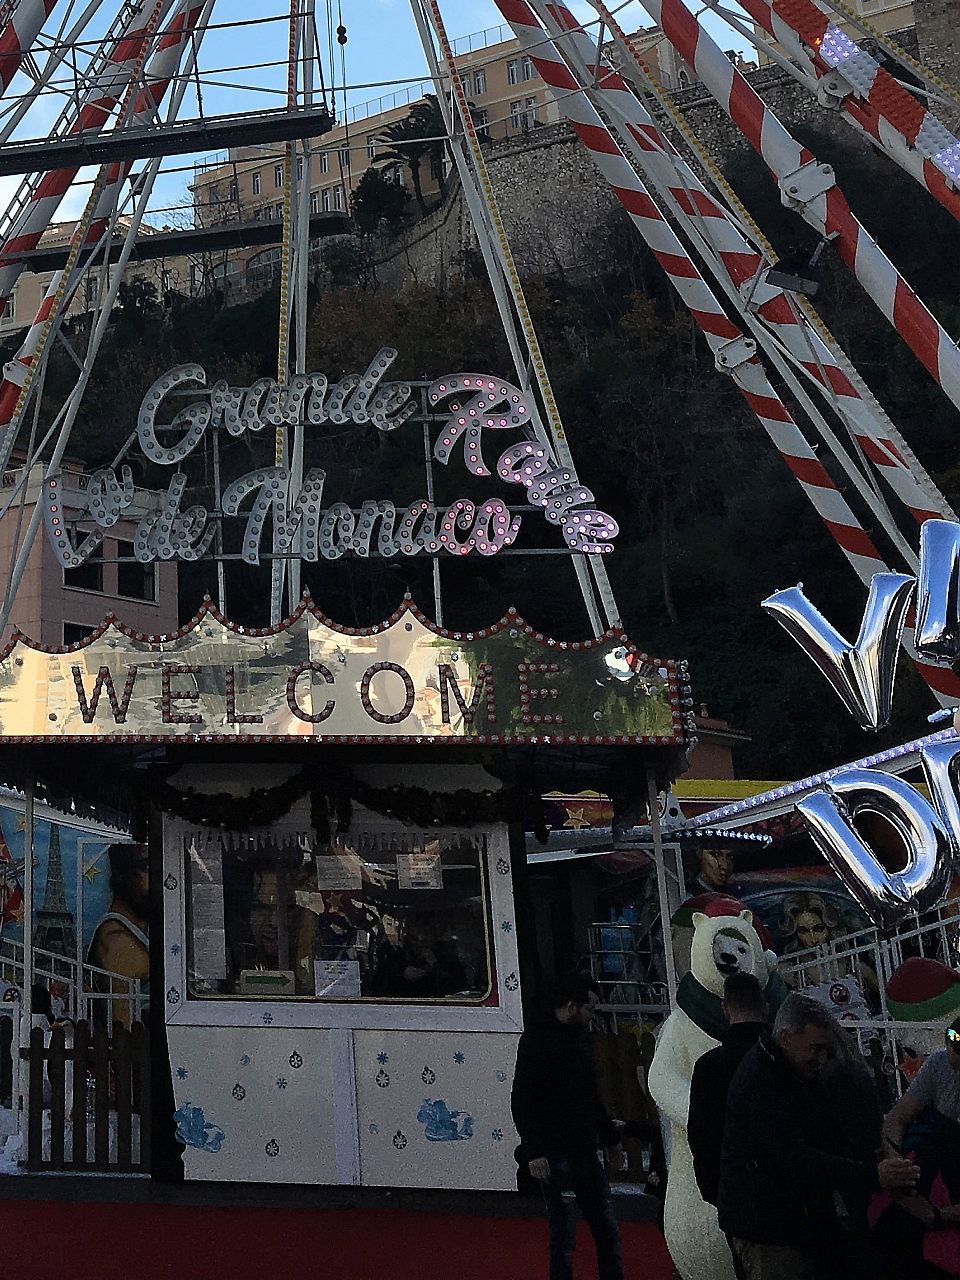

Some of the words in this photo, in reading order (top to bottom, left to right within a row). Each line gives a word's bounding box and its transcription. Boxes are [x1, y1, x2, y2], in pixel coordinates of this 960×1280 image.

[136, 346, 418, 465] Grande
[428, 372, 620, 554] Roue
[134, 472, 218, 563] de
[222, 466, 522, 565] Monaco
[71, 661, 564, 726] WELCOME
